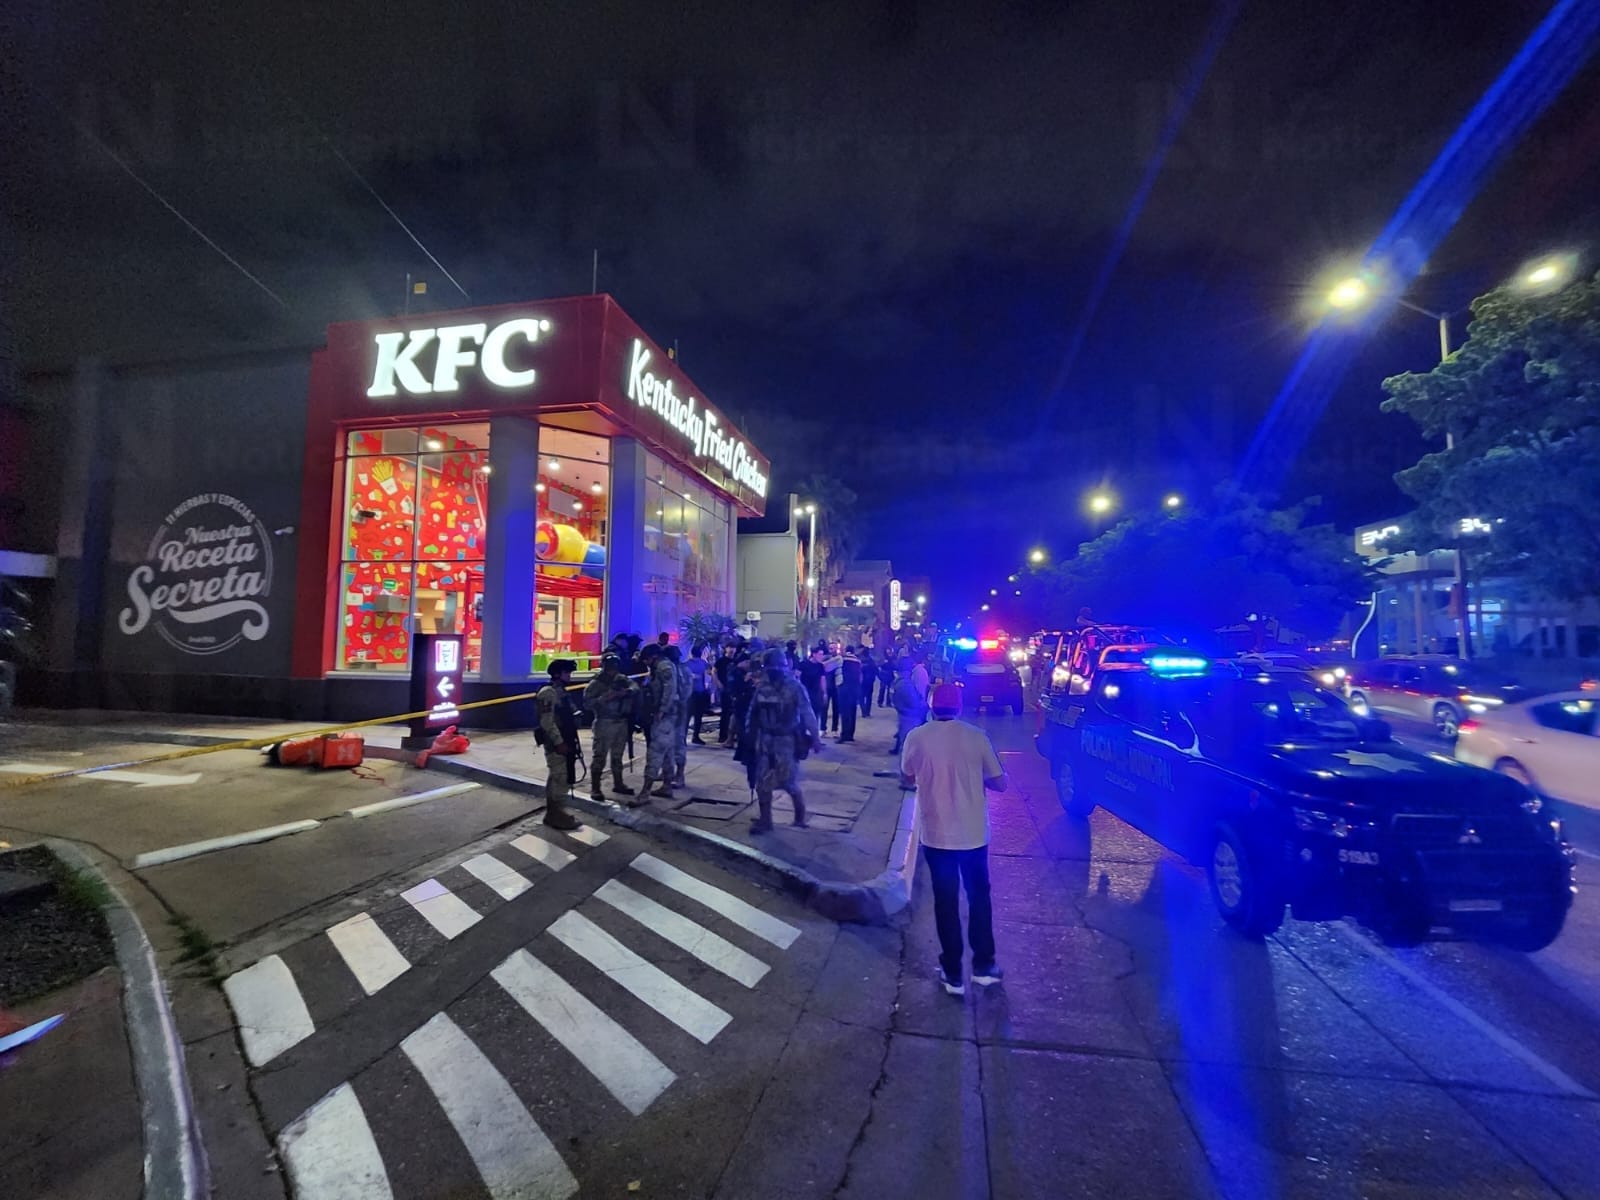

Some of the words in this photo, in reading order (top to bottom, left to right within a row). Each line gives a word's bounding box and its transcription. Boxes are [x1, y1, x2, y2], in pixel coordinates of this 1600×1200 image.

[367, 318, 541, 397] KFC
[628, 338, 704, 457] Kentucky
[703, 409, 735, 471] Fried
[731, 441, 767, 498] Chicken
[218, 494, 256, 523] ESPECIAS
[158, 538, 259, 572] Receta
[184, 524, 252, 546] Nuestra
[118, 565, 267, 635] Secreta
